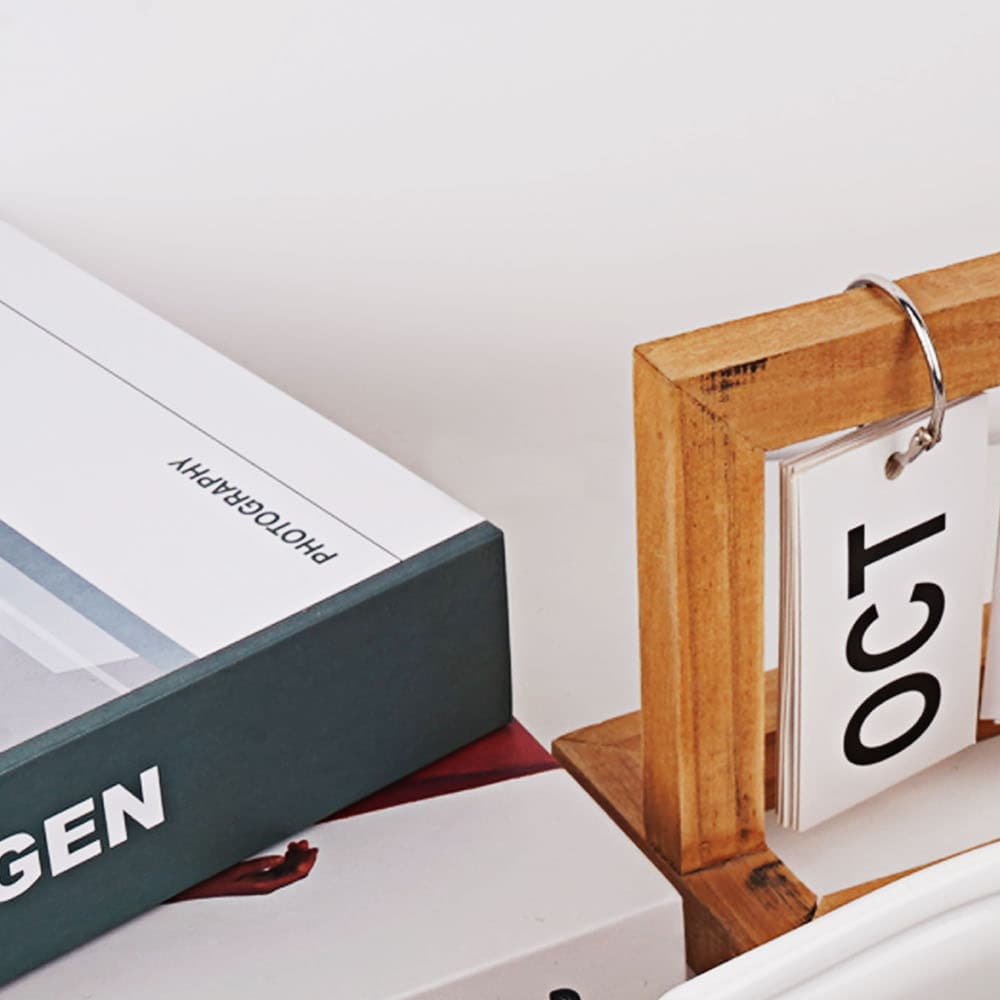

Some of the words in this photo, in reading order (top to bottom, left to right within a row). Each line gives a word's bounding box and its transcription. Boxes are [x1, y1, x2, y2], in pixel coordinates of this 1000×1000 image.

[168, 457, 338, 564] PHOTOGRAPHY
[843, 512, 946, 767] OCT
[0, 765, 165, 903] GEN
